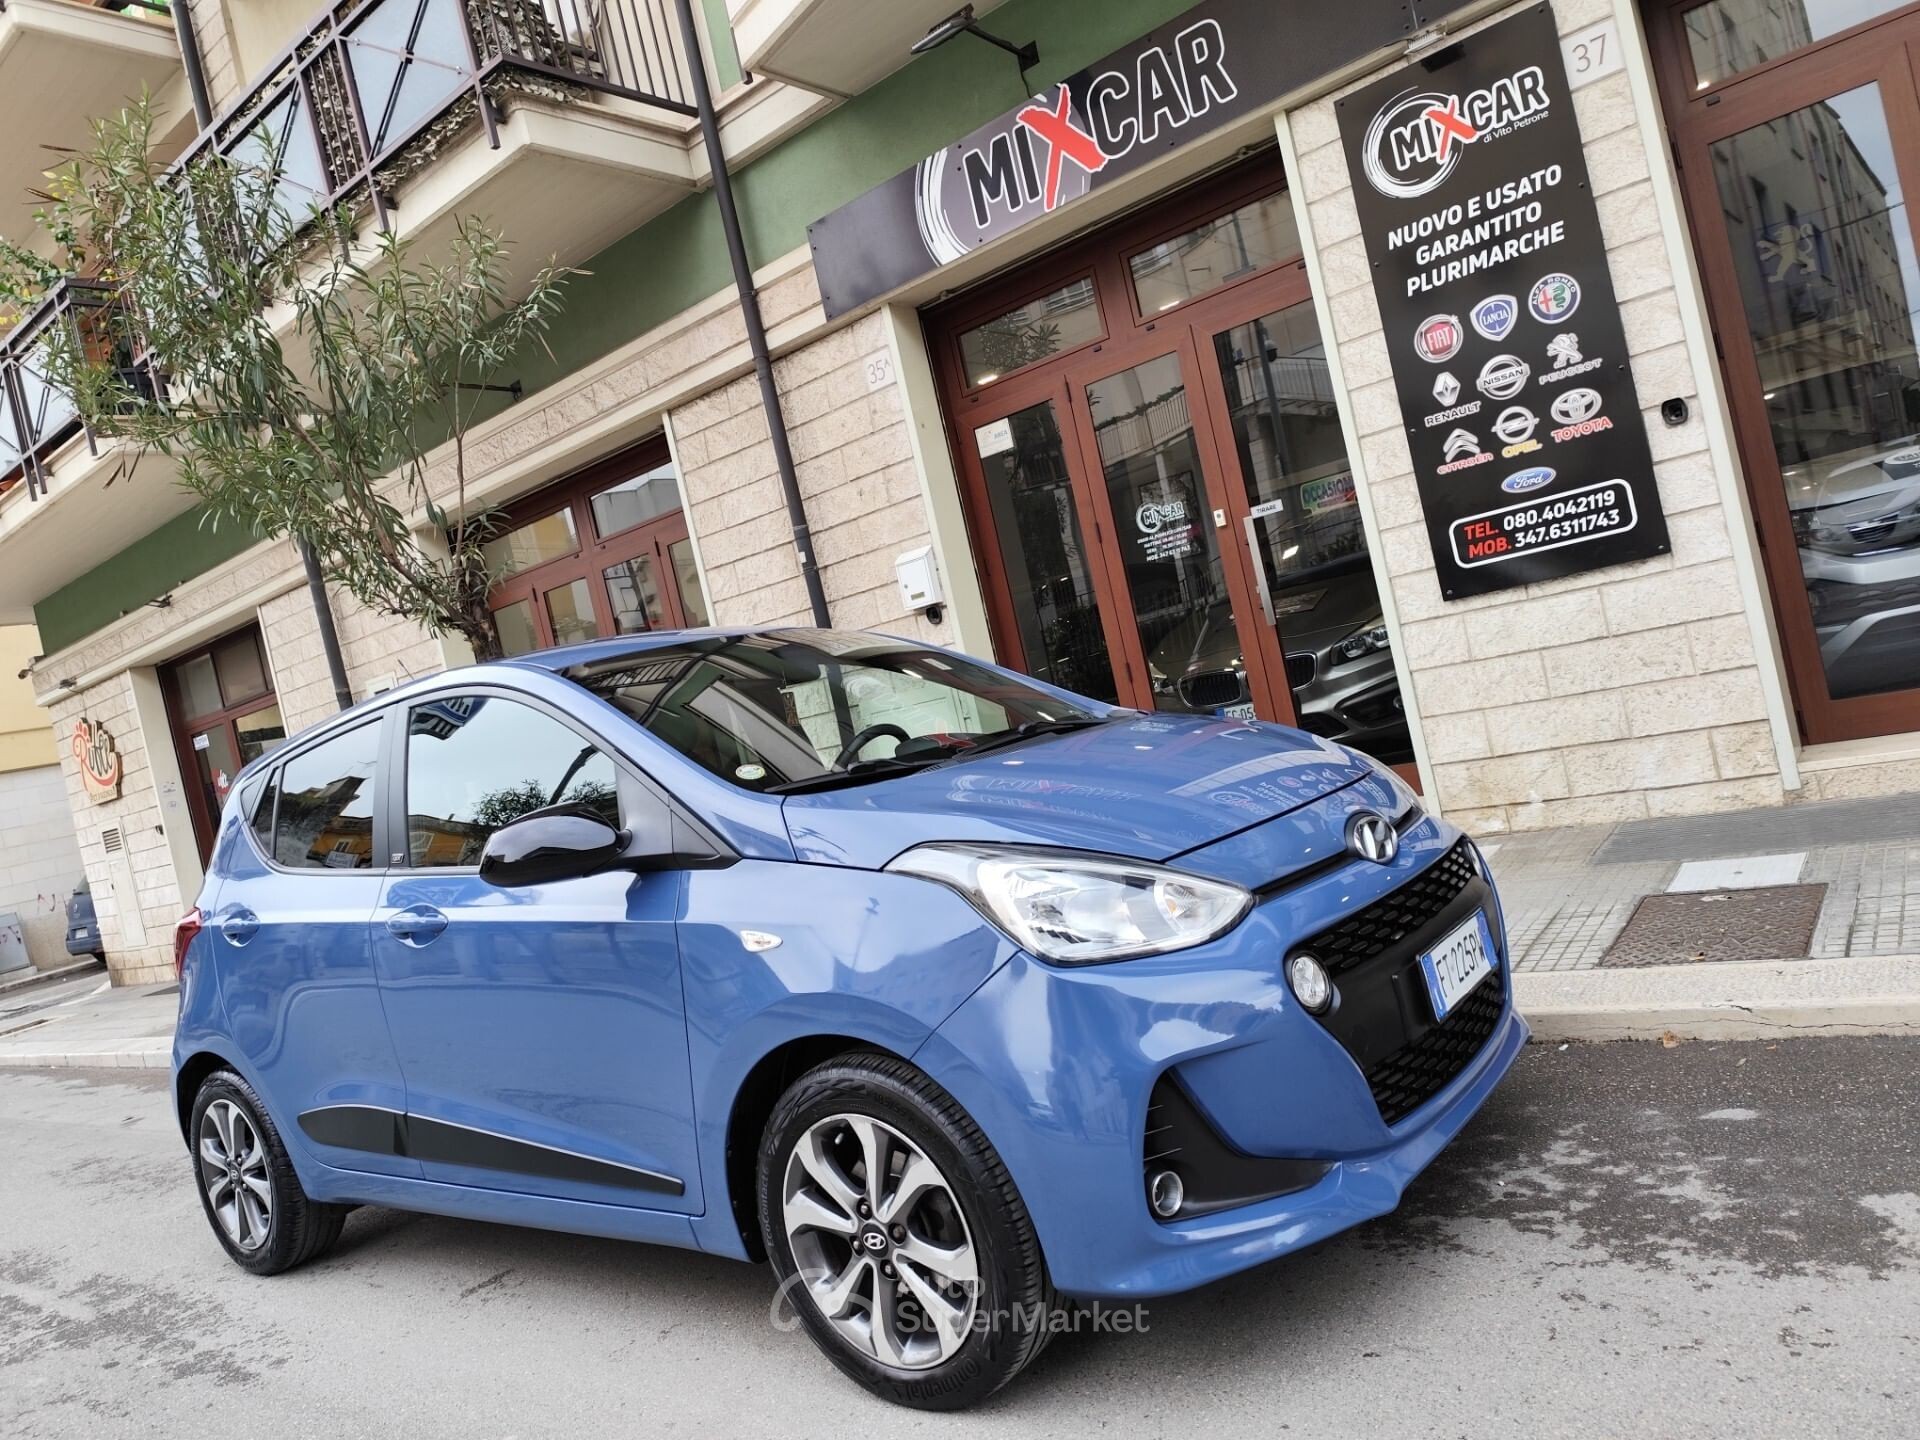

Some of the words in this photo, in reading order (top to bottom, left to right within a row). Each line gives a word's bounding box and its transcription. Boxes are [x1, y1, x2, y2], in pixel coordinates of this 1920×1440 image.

[1571, 33, 1607, 73] 37
[962, 18, 1238, 229] MIXCAR
[1389, 66, 1551, 172] MIXCAR
[1483, 132, 1493, 144] di
[1493, 126, 1513, 139] Vito
[1513, 110, 1550, 131] Petrone
[1387, 204, 1462, 251] NUOVO
[1467, 196, 1482, 220] E
[1485, 164, 1563, 211] USATO
[1415, 201, 1543, 266] GARANTITO
[1406, 220, 1566, 297] PLURIMARCHE
[1482, 308, 1509, 326] LANCIA
[1426, 325, 1452, 351] FIAT
[1483, 368, 1524, 386] NISSAN
[1539, 357, 1602, 385] PEUGEOT
[1424, 401, 1481, 427] RENAULT
[1551, 416, 1613, 443] TOYOTA
[1501, 439, 1543, 458] OPEL
[1513, 472, 1544, 489] Ford
[1255, 504, 1277, 514] TIRARE
[1464, 521, 1499, 540] TEL.
[1503, 489, 1615, 531] 080.4042119
[1468, 537, 1512, 559] MOB.
[1514, 509, 1620, 548] 347.6311743
[1436, 954, 1455, 998] FT
